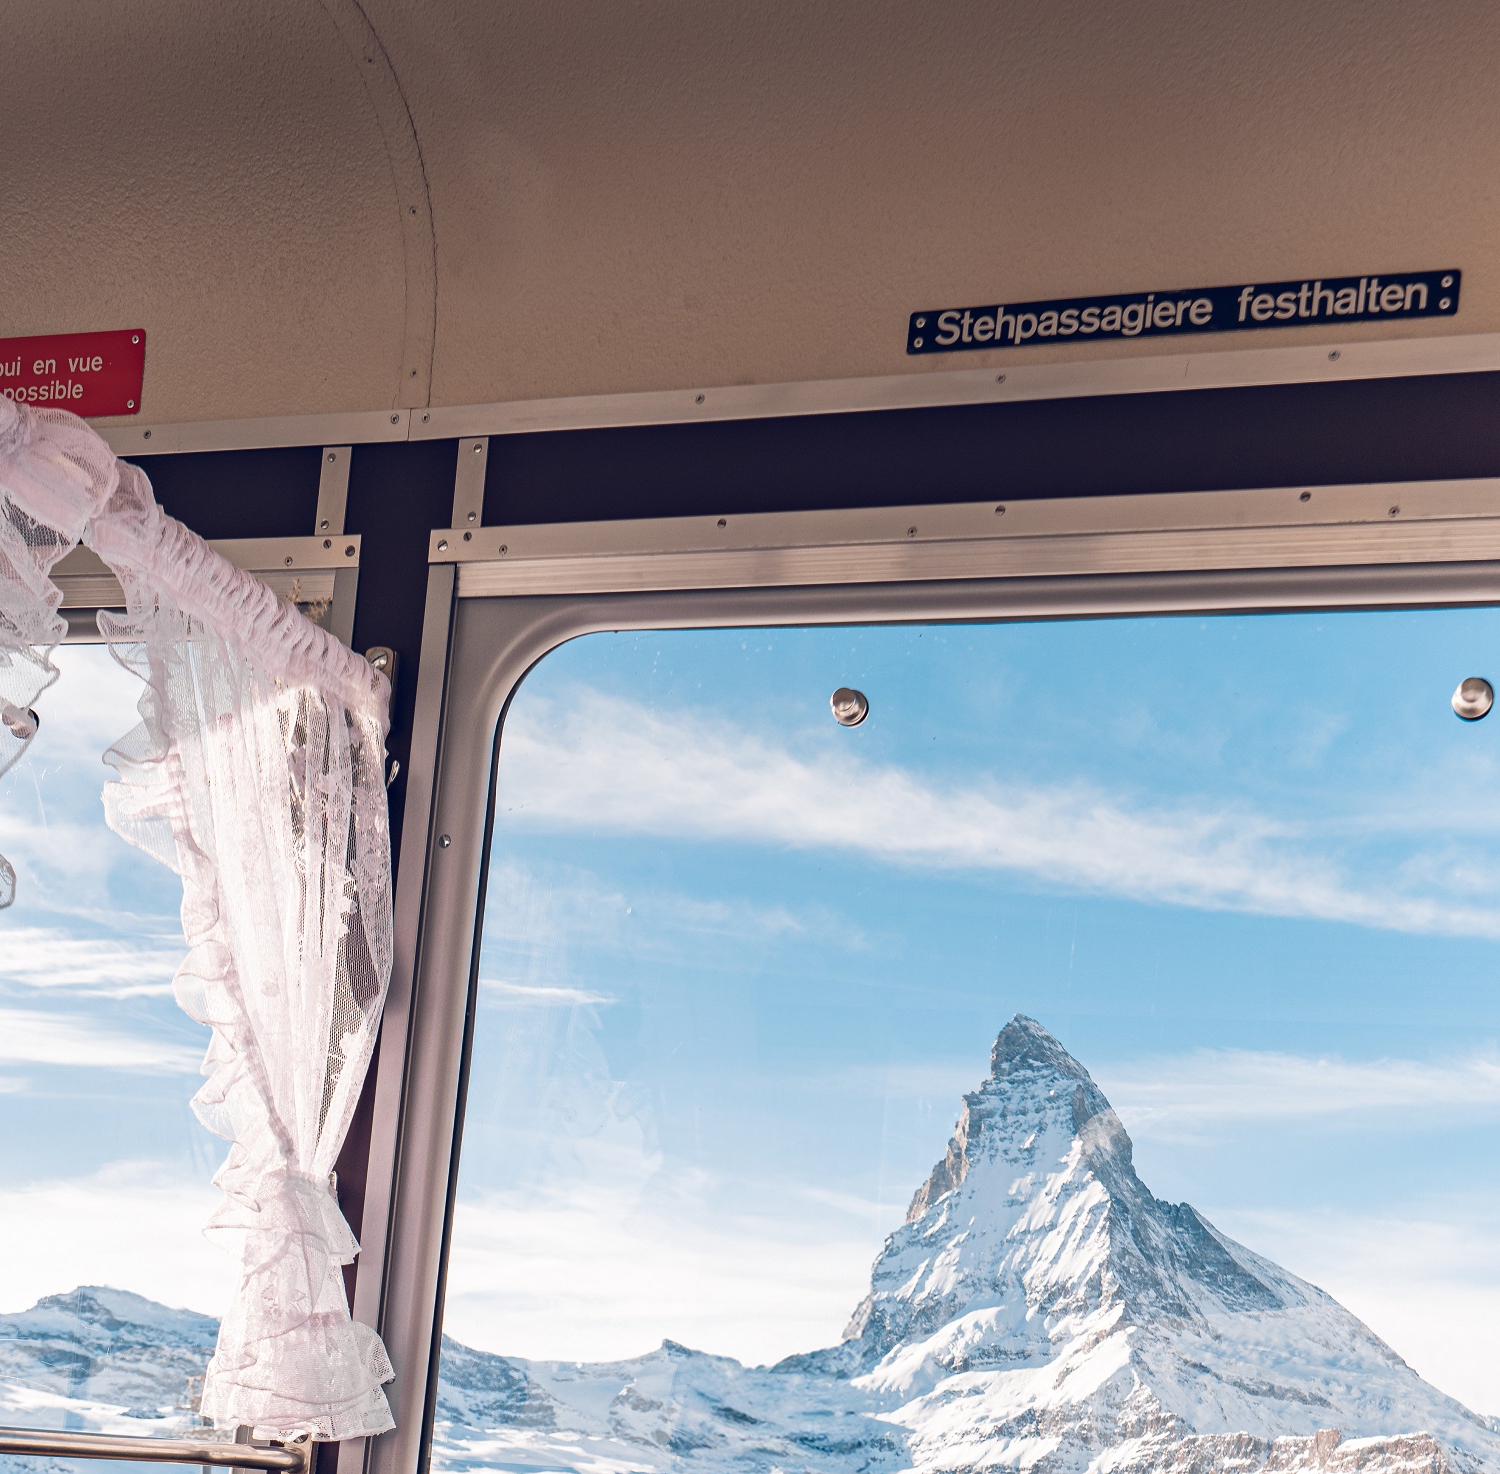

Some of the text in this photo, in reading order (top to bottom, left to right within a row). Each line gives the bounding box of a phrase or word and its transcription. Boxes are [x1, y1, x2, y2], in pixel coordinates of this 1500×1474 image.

[934, 278, 1430, 346] Stehpassagiere festhalten
[32, 358, 56, 376] en
[68, 355, 103, 373] vue
[3, 379, 84, 402] possible
